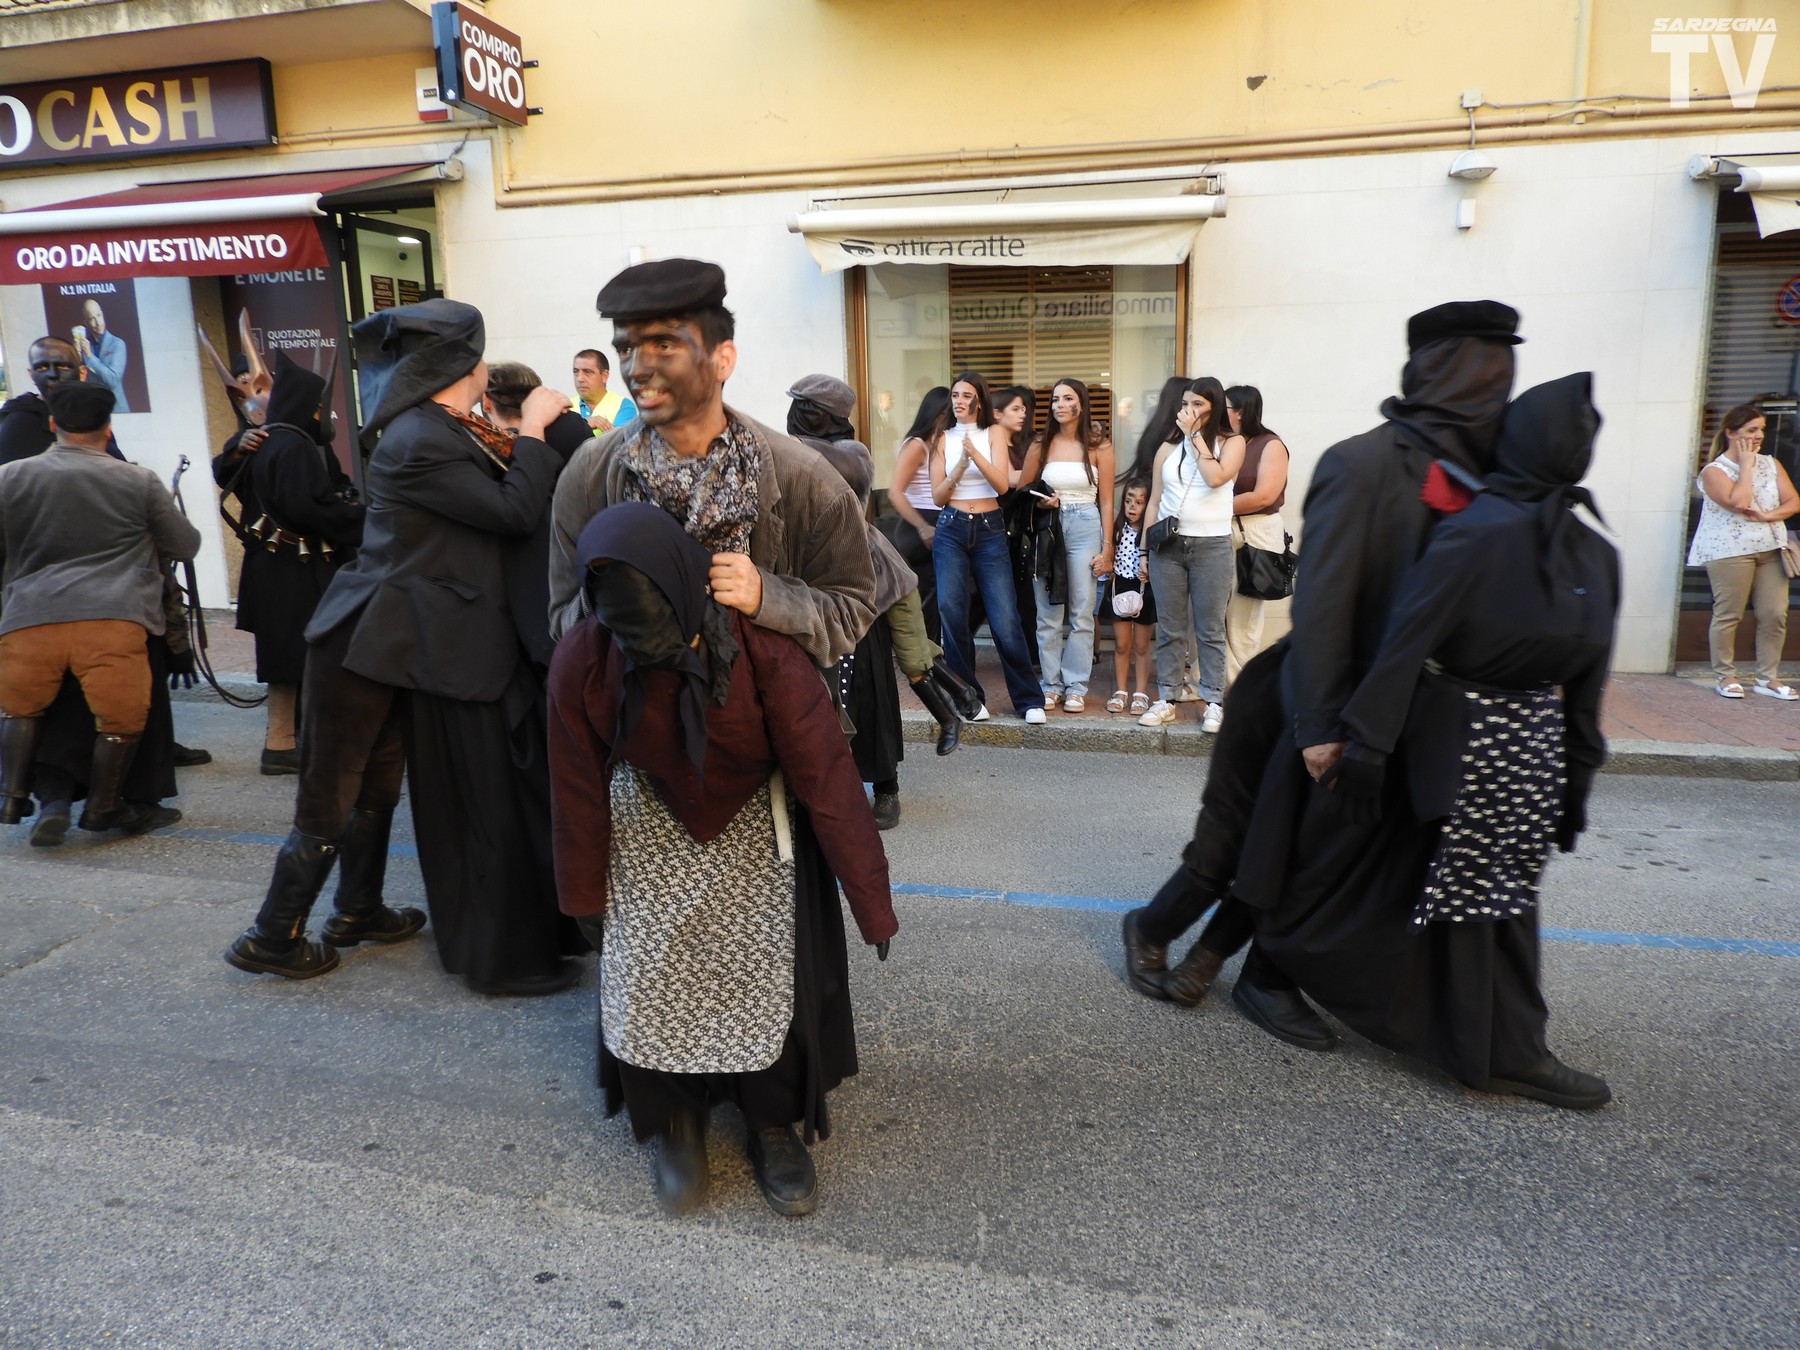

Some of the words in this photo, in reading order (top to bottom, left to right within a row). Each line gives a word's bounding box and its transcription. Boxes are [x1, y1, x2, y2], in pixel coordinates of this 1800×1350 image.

[462, 20, 521, 68] COMPRO
[464, 47, 524, 109] ORO
[16, 245, 67, 271] ORO
[71, 242, 105, 268] DA
[107, 233, 288, 265] INVESTIMENTO
[76, 284, 87, 294] IN
[88, 282, 117, 294] ITALIA
[267, 328, 321, 340] QUOTAZIONI
[268, 340, 279, 350] IN
[279, 339, 309, 349] TEMPO
[310, 338, 336, 348] RALE
